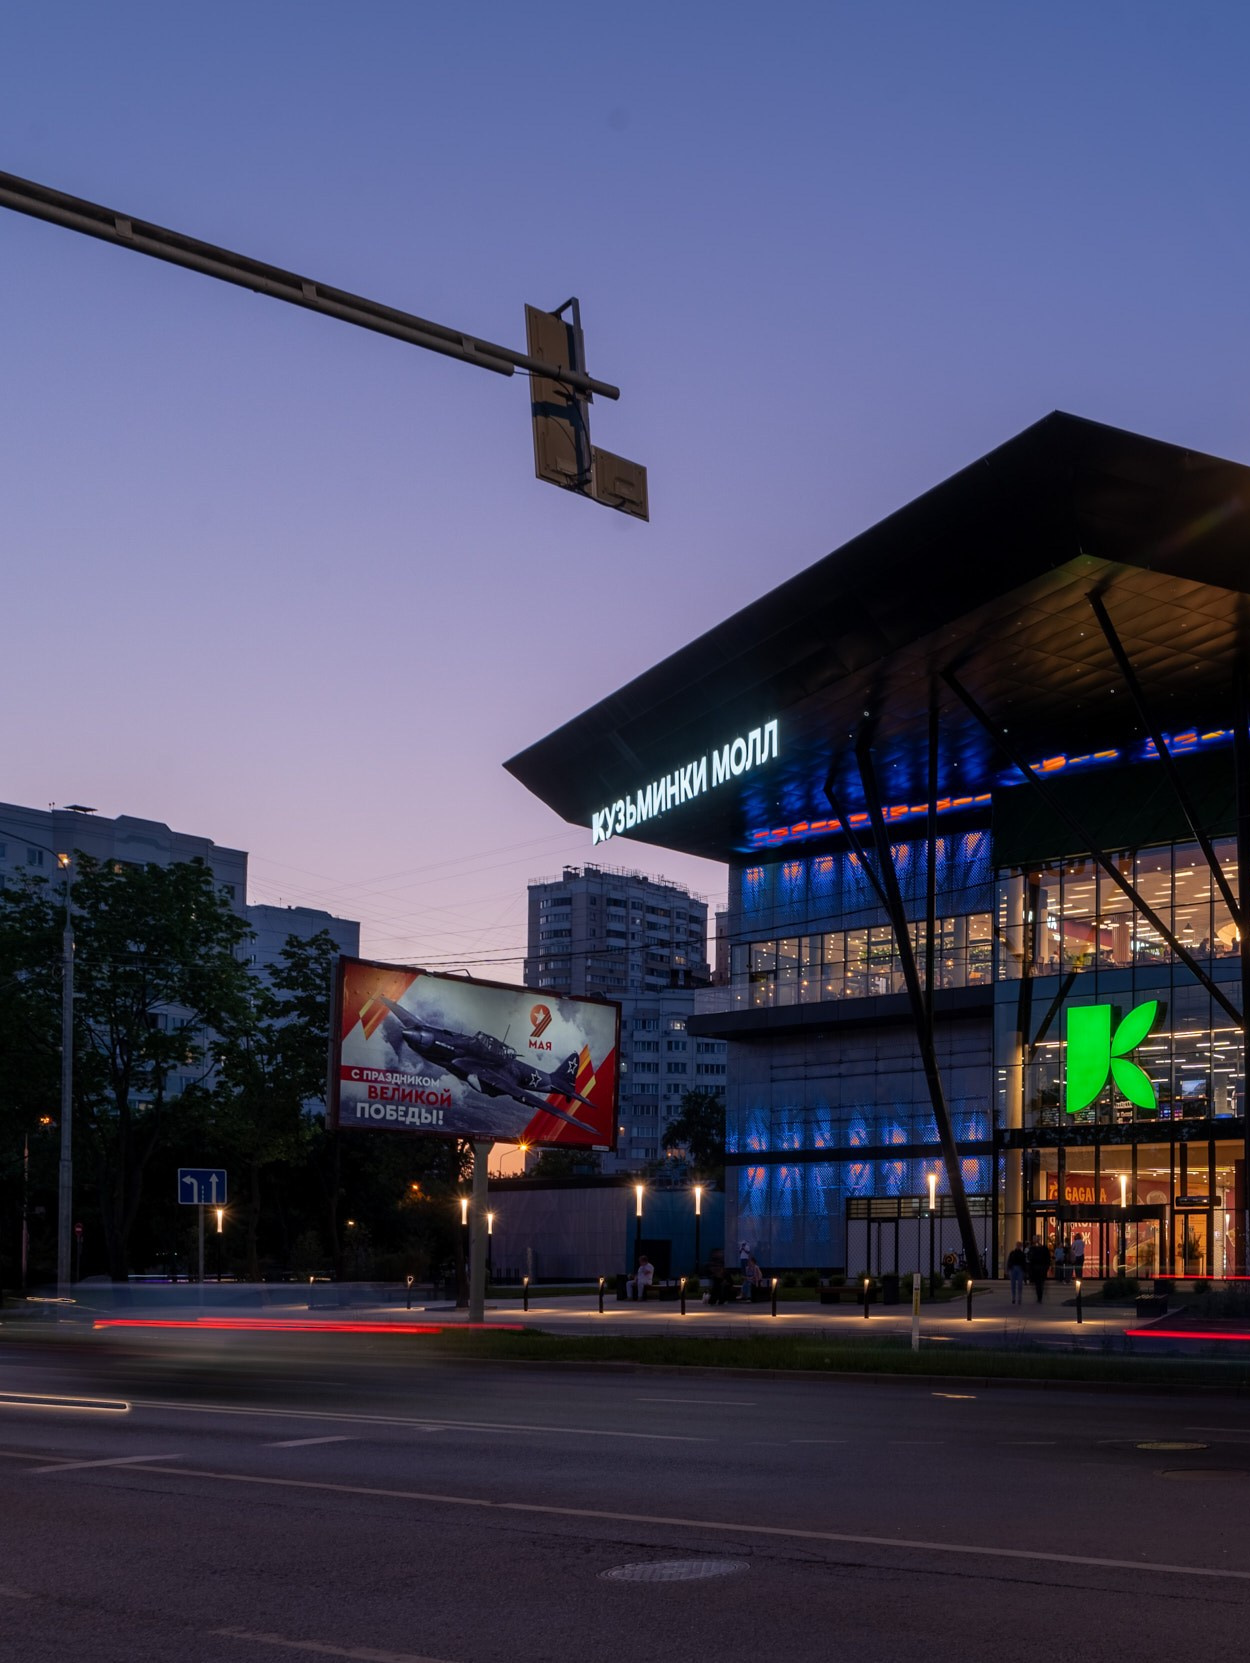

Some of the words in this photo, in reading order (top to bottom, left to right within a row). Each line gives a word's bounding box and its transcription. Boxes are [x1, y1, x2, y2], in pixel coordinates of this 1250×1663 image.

[592, 756, 707, 846] КУЗЬМИНКИ
[712, 719, 778, 787] МОЛЛ
[530, 1004, 552, 1037] 9
[528, 1039, 552, 1051] МАЯ
[351, 1069, 360, 1079] С
[363, 1070, 440, 1087] ПРАЗДНИКОМ
[368, 1085, 452, 1107] ВЕЛИКОЙ
[356, 1102, 444, 1125] ПОБЕДЫ!
